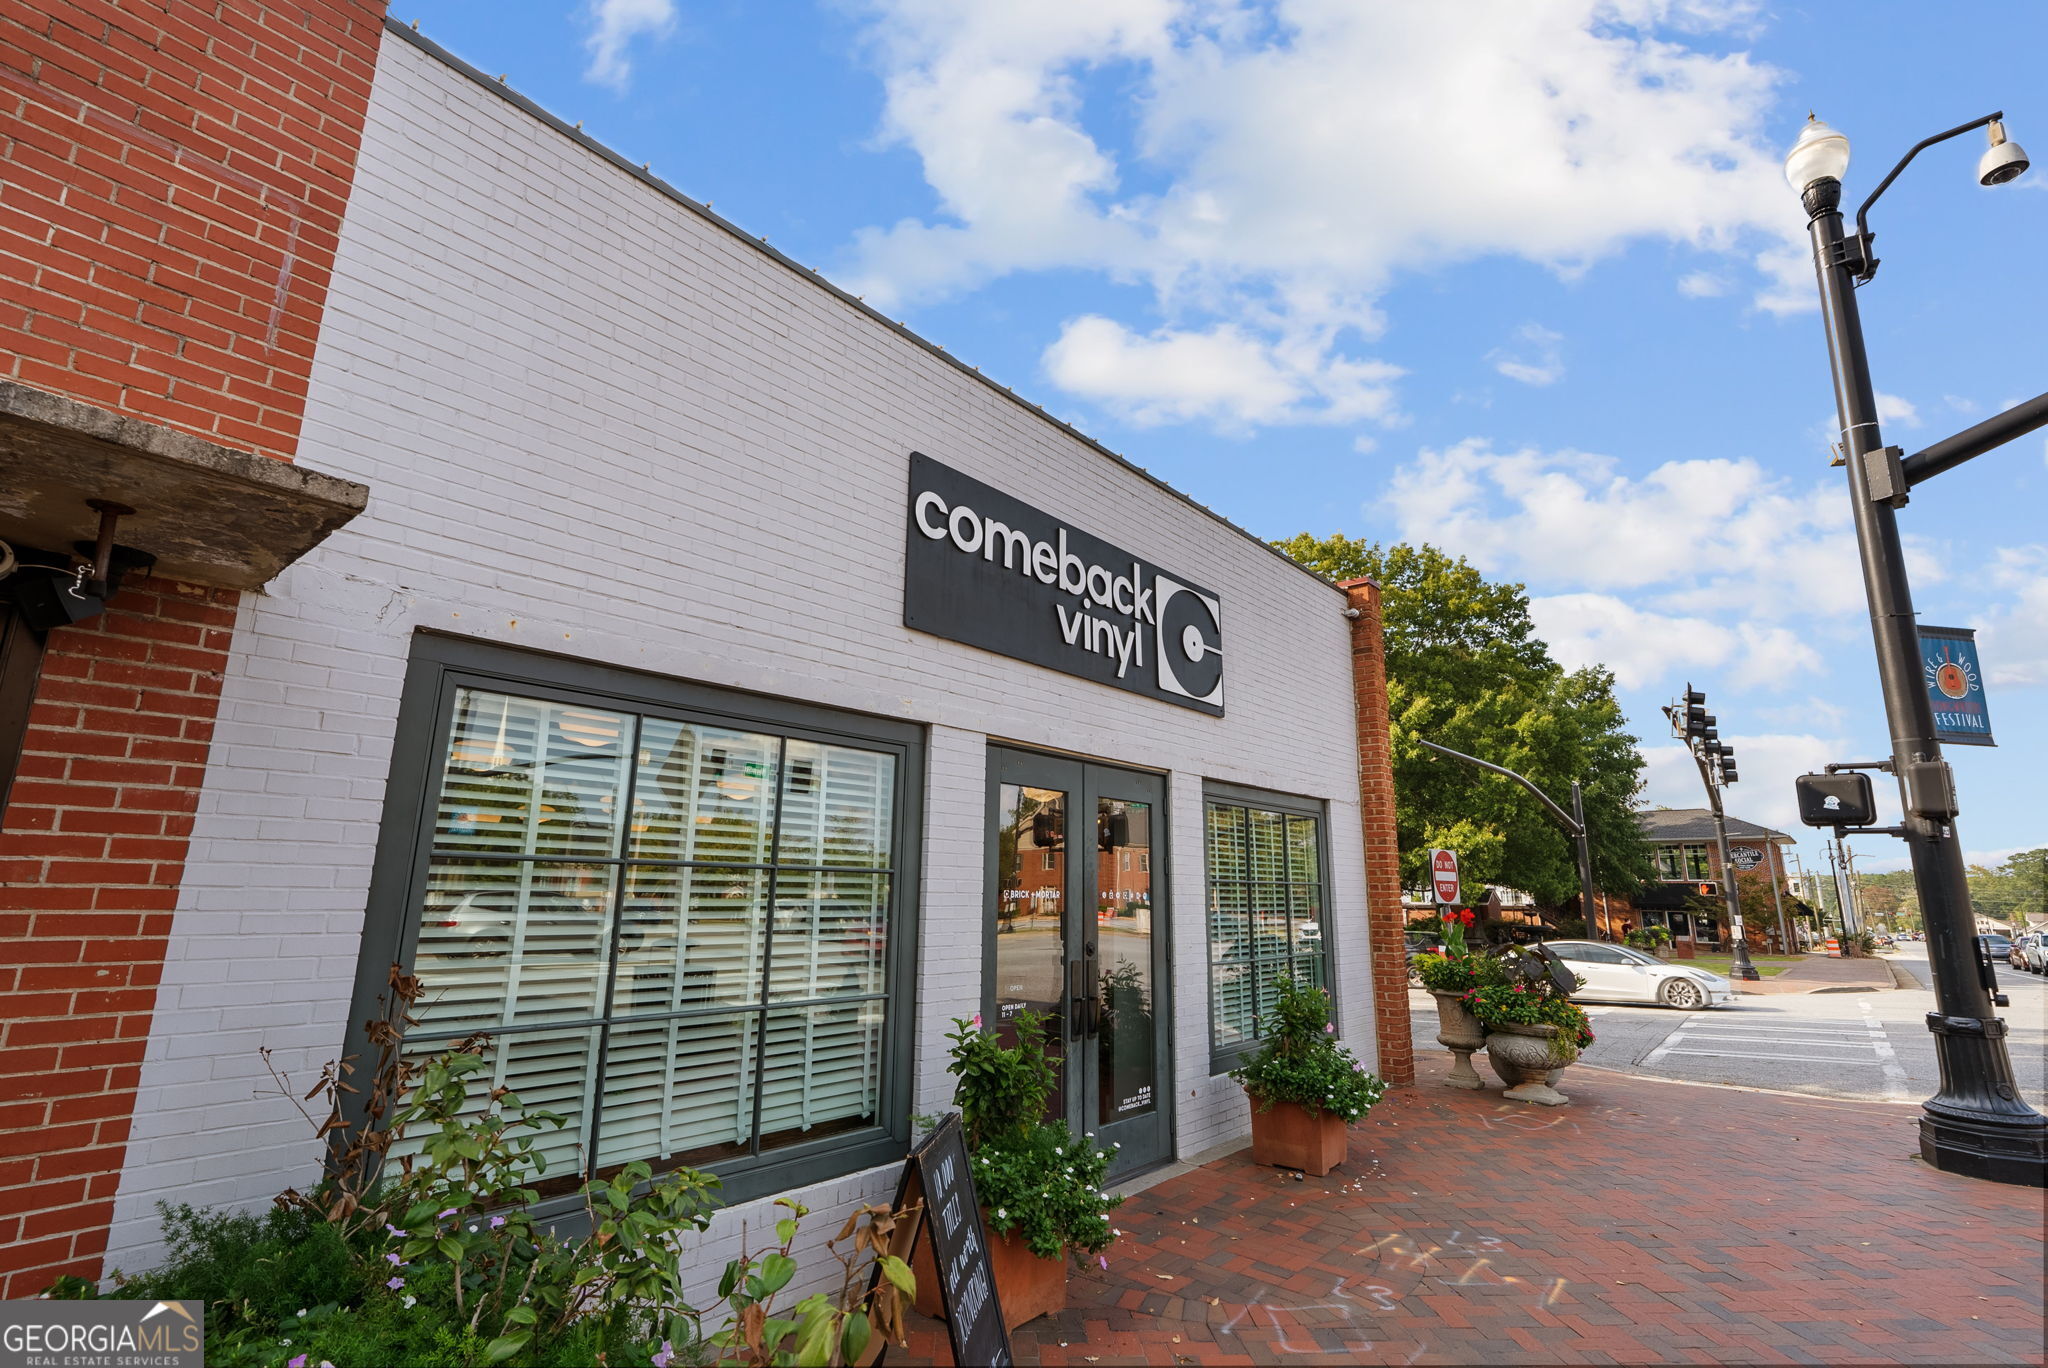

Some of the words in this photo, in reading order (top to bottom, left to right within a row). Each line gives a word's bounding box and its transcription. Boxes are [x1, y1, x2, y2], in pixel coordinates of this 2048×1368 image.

[915, 491, 1156, 626] comeback
[1056, 598, 1143, 679] vinyl
[1925, 657, 1938, 689] WIRE
[1958, 652, 1980, 691] WOOD
[1933, 712, 1985, 729] FESTIVAL
[1435, 860, 1443, 869] DO
[1444, 860, 1454, 870] NOT
[1010, 890, 1030, 898] BRICK
[1036, 890, 1060, 899] MORTAR
[1439, 883, 1455, 893] ENTER
